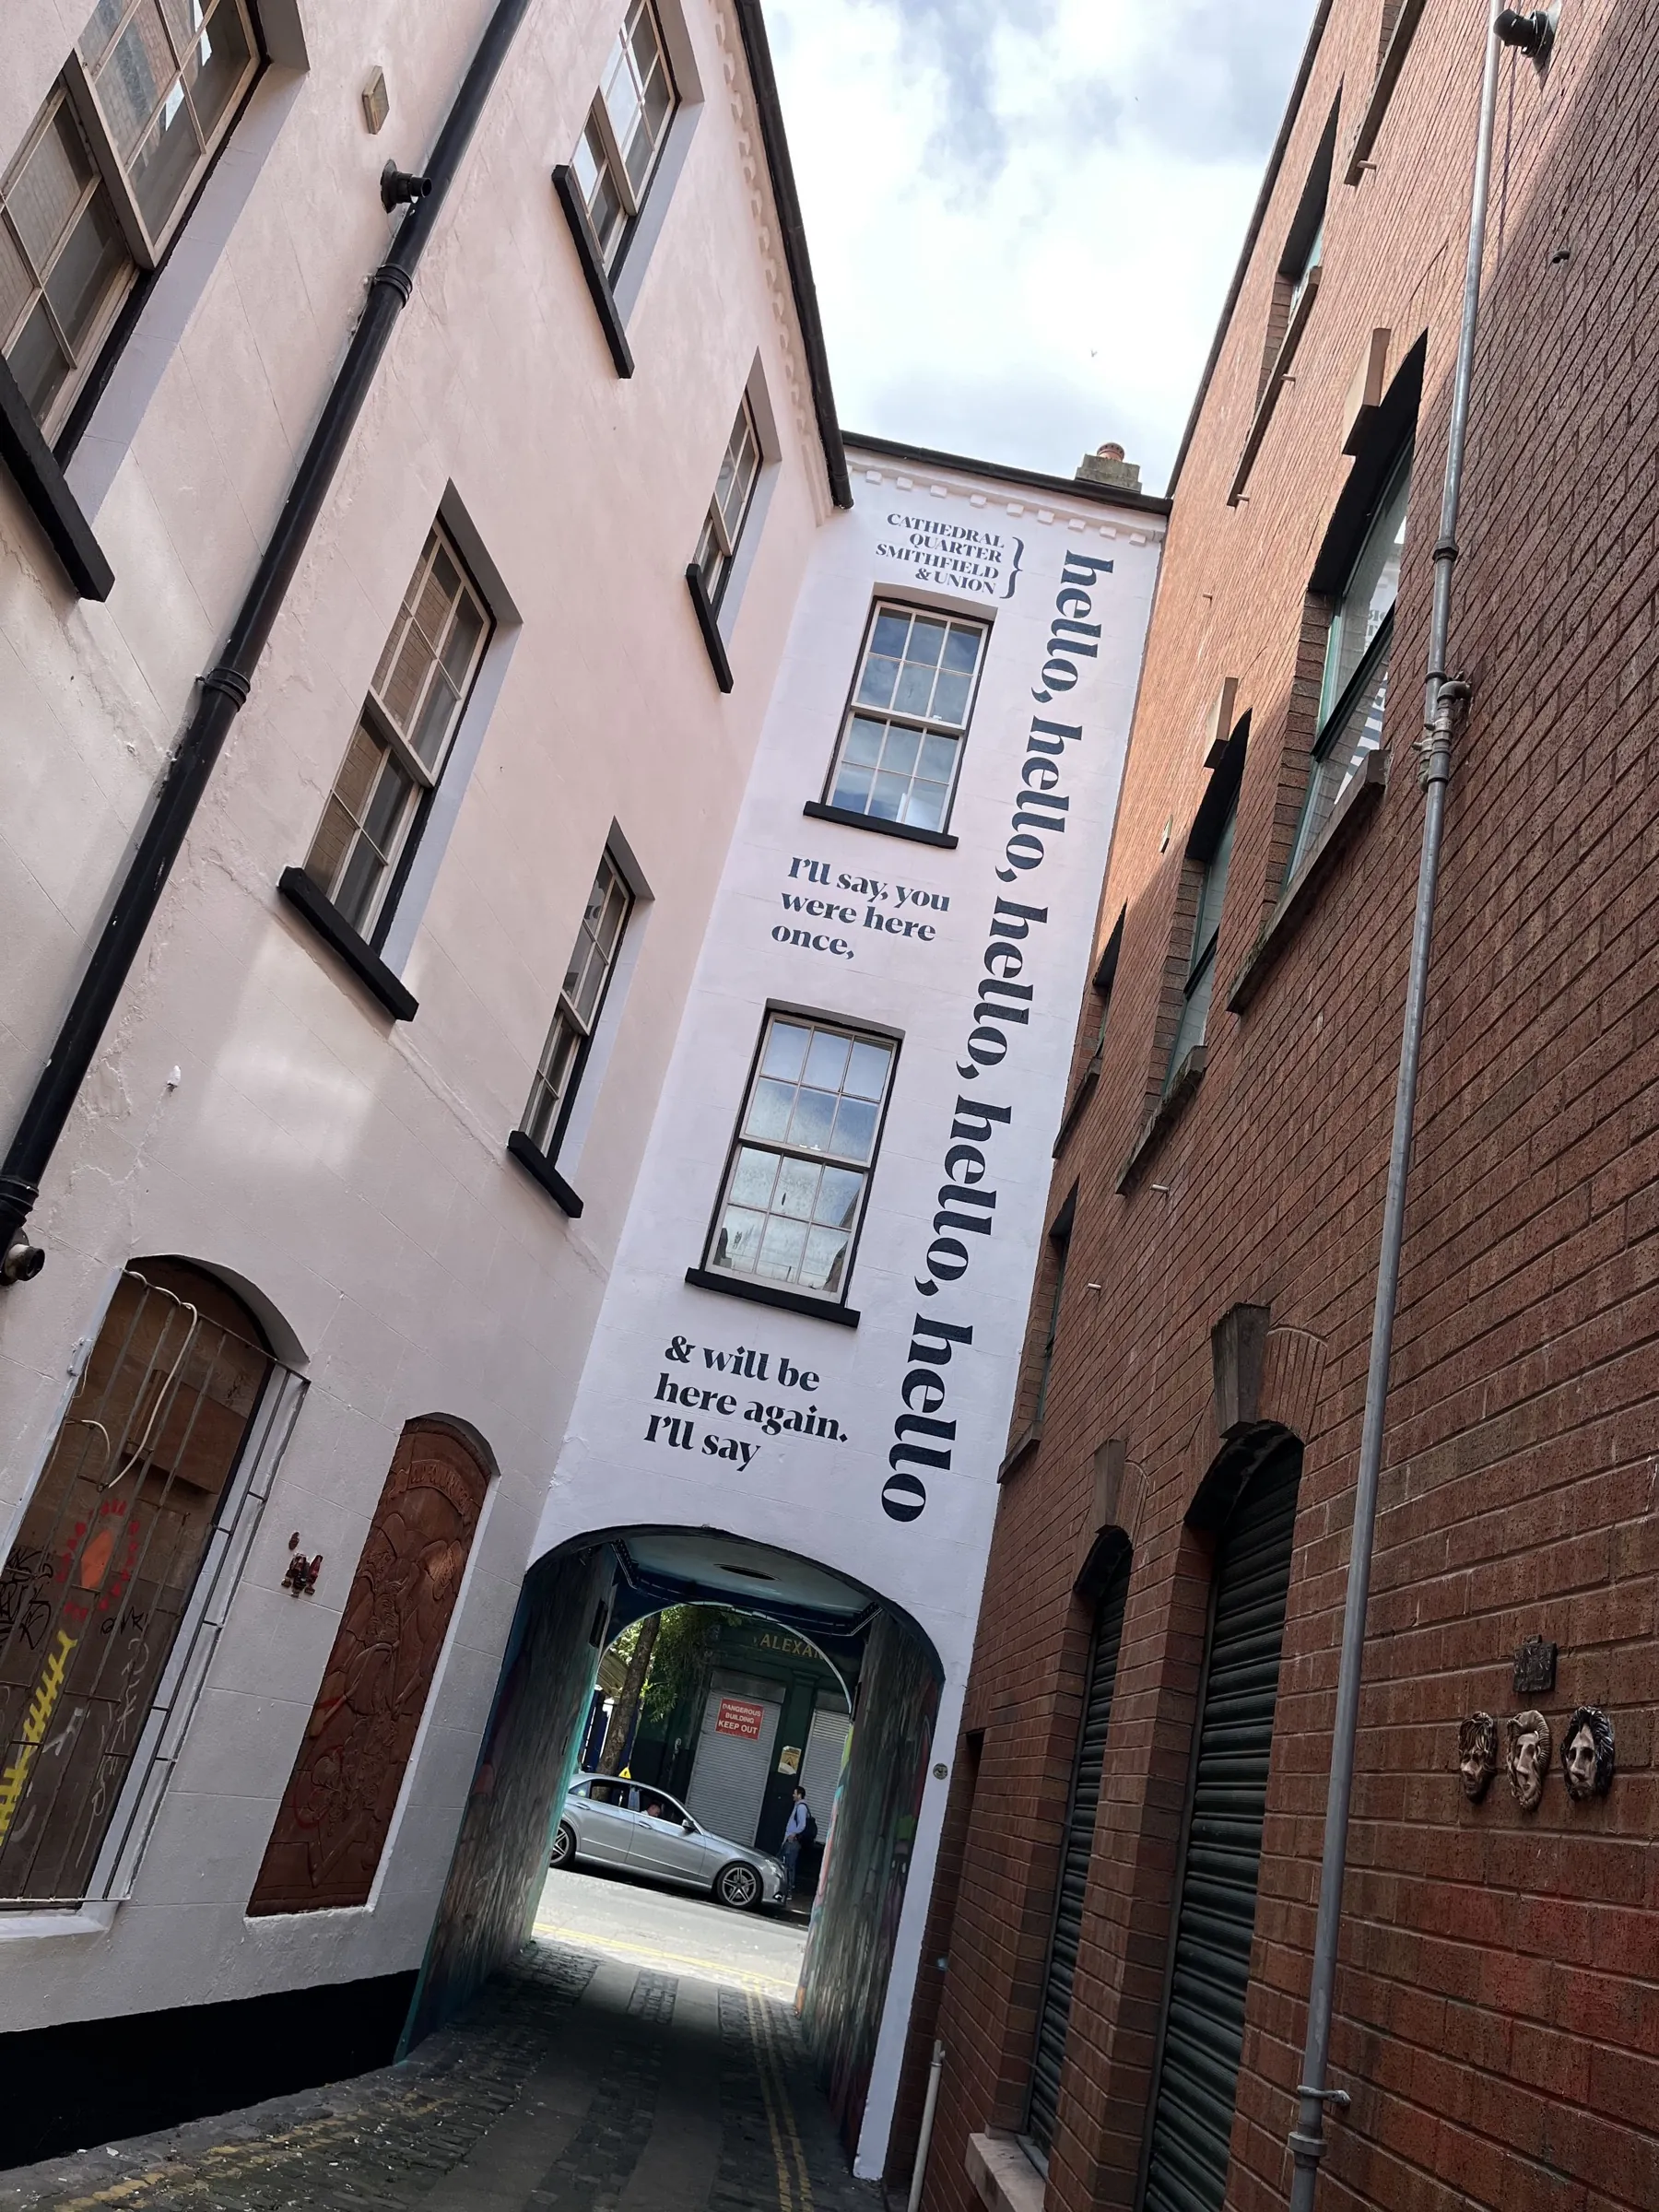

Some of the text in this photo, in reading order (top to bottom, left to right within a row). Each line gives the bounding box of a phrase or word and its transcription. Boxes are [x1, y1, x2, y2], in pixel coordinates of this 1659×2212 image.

[887, 513, 1005, 548] CATHEDRAL
[909, 533, 1003, 563] QUARTER
[876, 543, 999, 579] SMITHFIELD
[935, 571, 996, 594] UNION
[787, 856, 950, 912] I'll say, you
[781, 892, 936, 941] were here
[771, 924, 854, 959] once,
[880, 549, 1114, 1523] hello, hello, hello, hello, hello
[665, 1335, 820, 1392] & will be
[653, 1372, 849, 1443] here again.
[643, 1414, 761, 1472] I'll say
[718, 1719, 759, 1735] KEEP OUT
[722, 1703, 761, 1717] DANGEROUS
[724, 1712, 755, 1724] BUILDING
